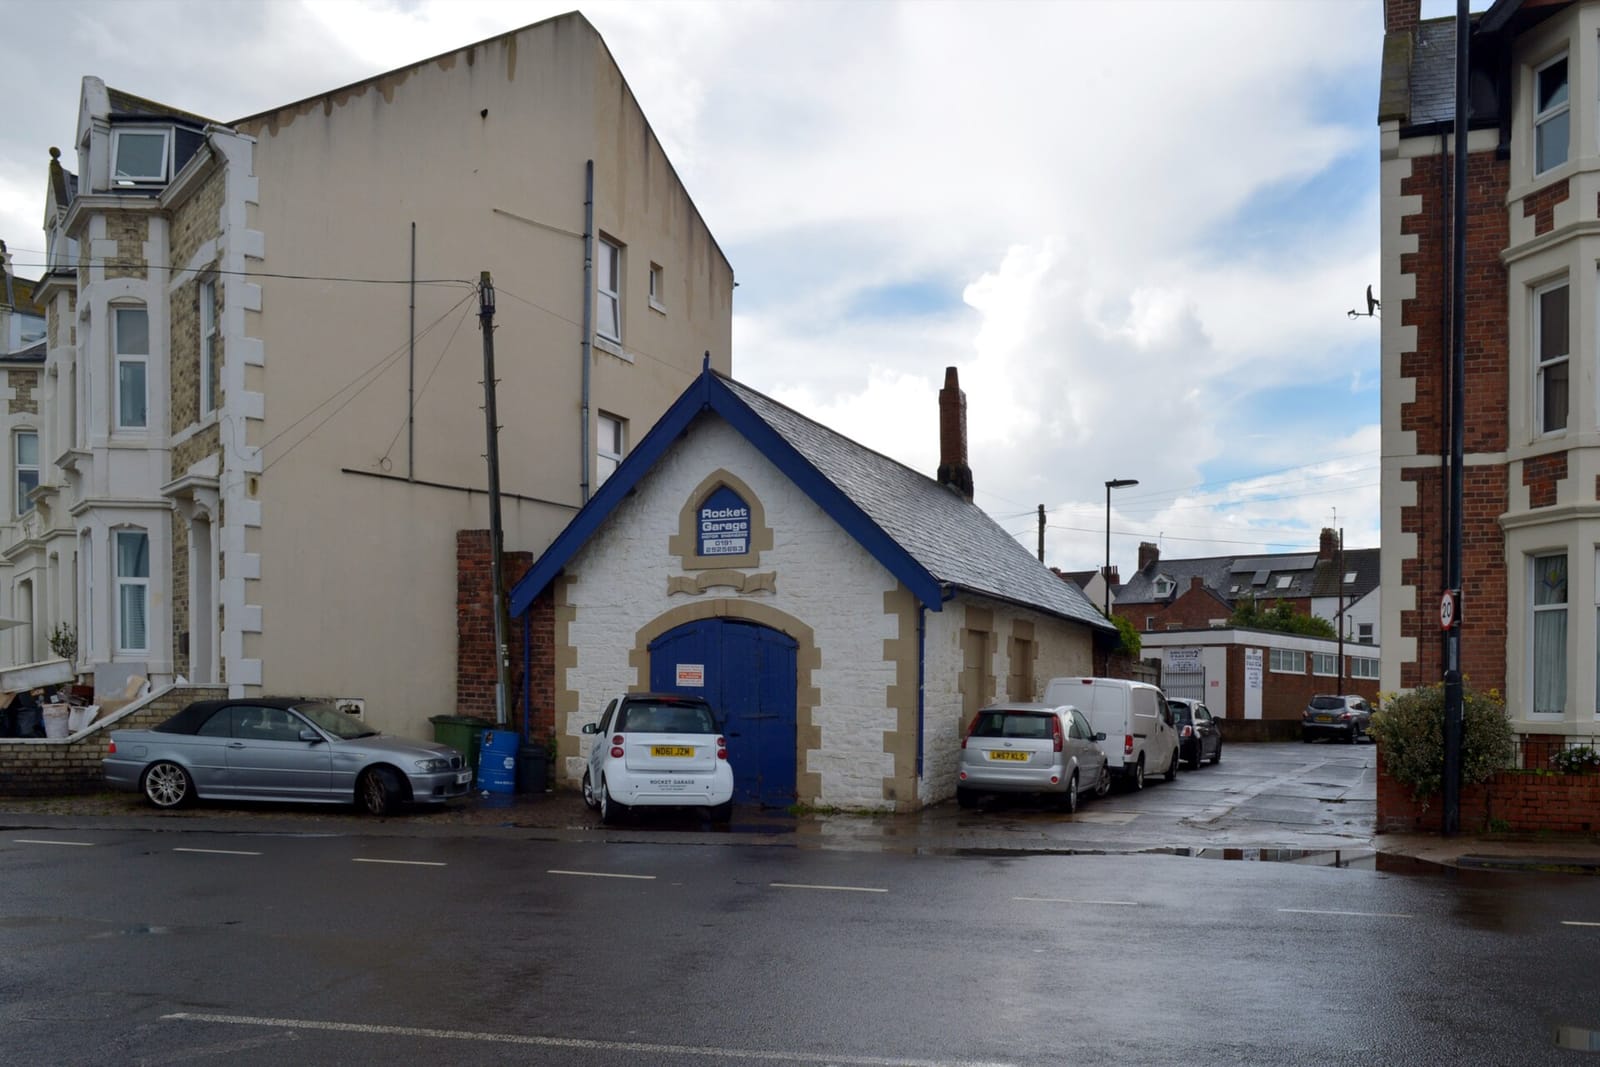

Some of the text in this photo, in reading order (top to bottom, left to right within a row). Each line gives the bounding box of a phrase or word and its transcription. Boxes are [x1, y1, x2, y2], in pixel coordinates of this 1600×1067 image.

[702, 508, 747, 518] Rocket
[702, 522, 747, 532] Garage
[1442, 602, 1451, 618] 20
